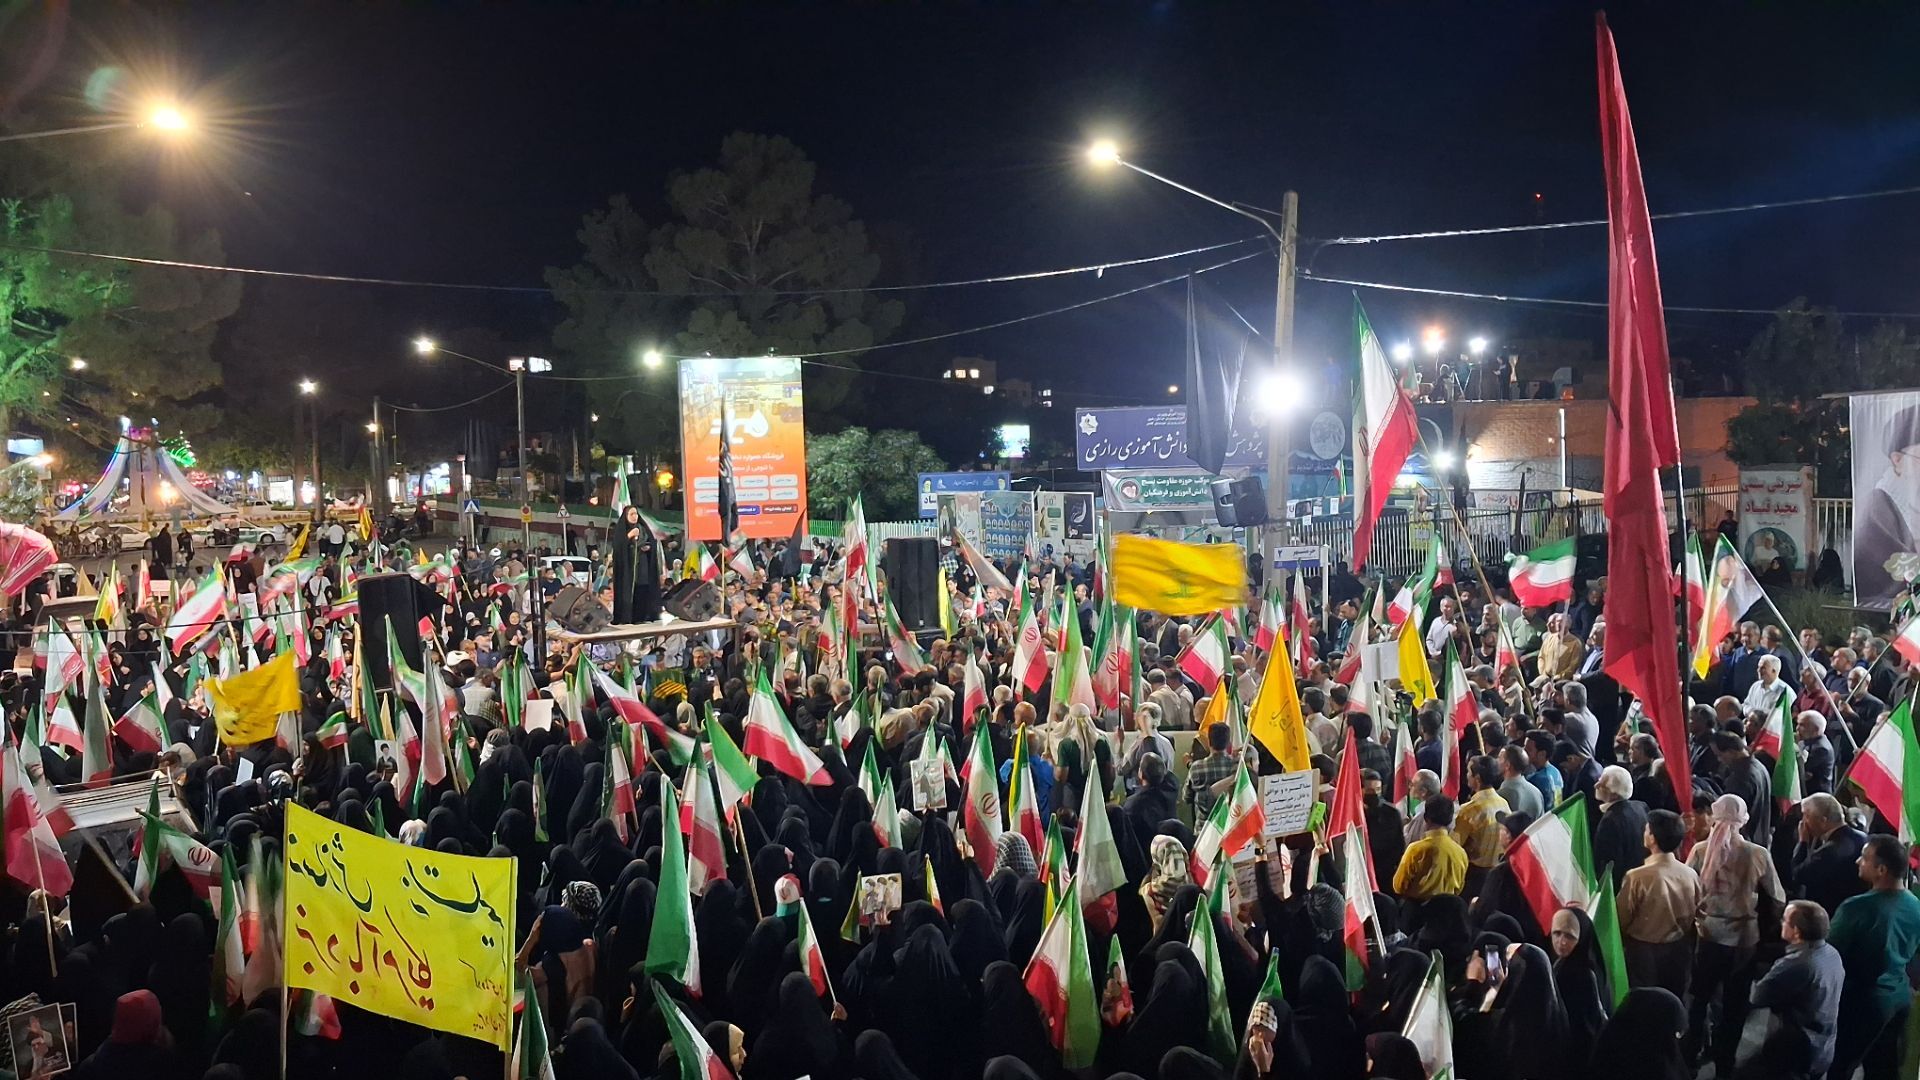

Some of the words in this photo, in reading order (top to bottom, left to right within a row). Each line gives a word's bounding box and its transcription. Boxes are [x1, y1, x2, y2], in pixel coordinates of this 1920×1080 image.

[1085, 438, 1118, 462] رازی
[1118, 435, 1164, 461] آموزی
[1159, 431, 1188, 459] دانش
[1141, 478, 1156, 487] بسیج
[1156, 477, 1178, 486] مقاومت
[1179, 478, 1193, 486] حوزه
[1143, 488, 1169, 498] فرهنگیان
[1774, 503, 1798, 516] مجید
